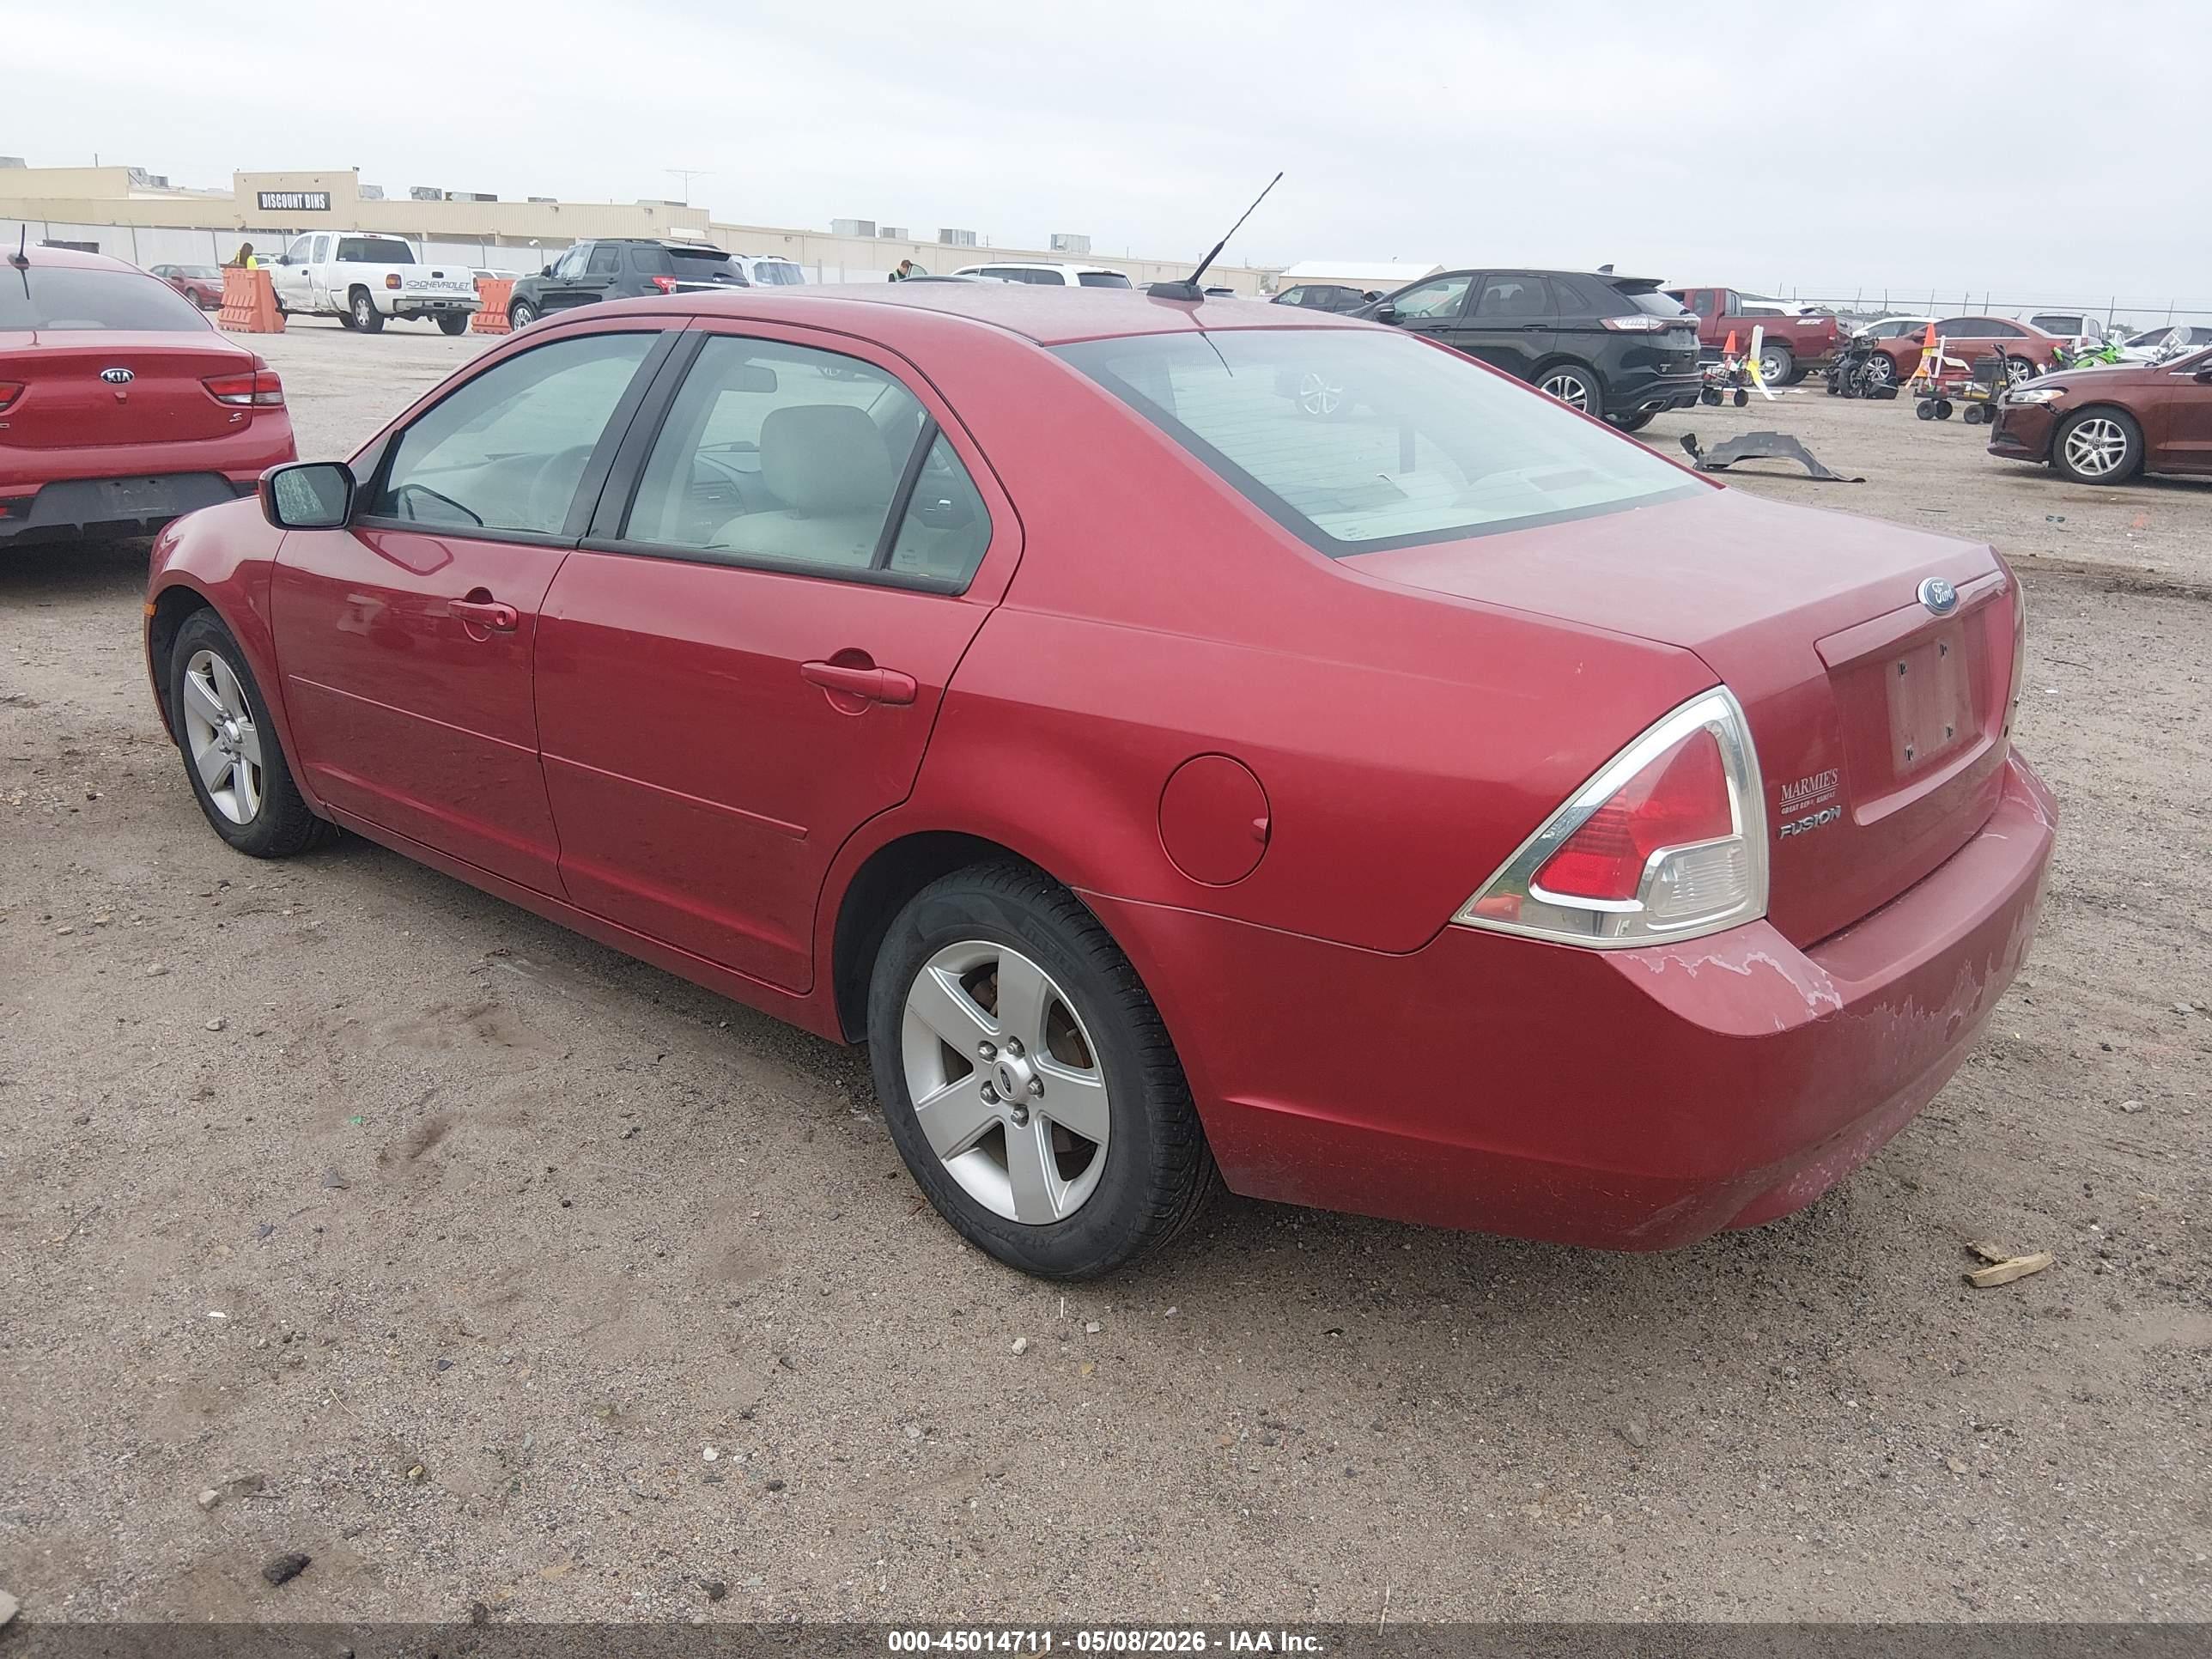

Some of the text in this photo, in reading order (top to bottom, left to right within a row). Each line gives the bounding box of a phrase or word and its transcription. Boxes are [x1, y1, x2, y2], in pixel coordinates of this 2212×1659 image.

[261, 193, 325, 210] DISCOUNT BINS
[419, 280, 471, 290] CHEVROLET
[106, 372, 131, 382] KIA
[228, 412, 243, 422] S
[1931, 581, 1954, 605] Ford
[1780, 767, 1838, 802] MARMIE'S
[1779, 805, 1841, 840] FUSION
